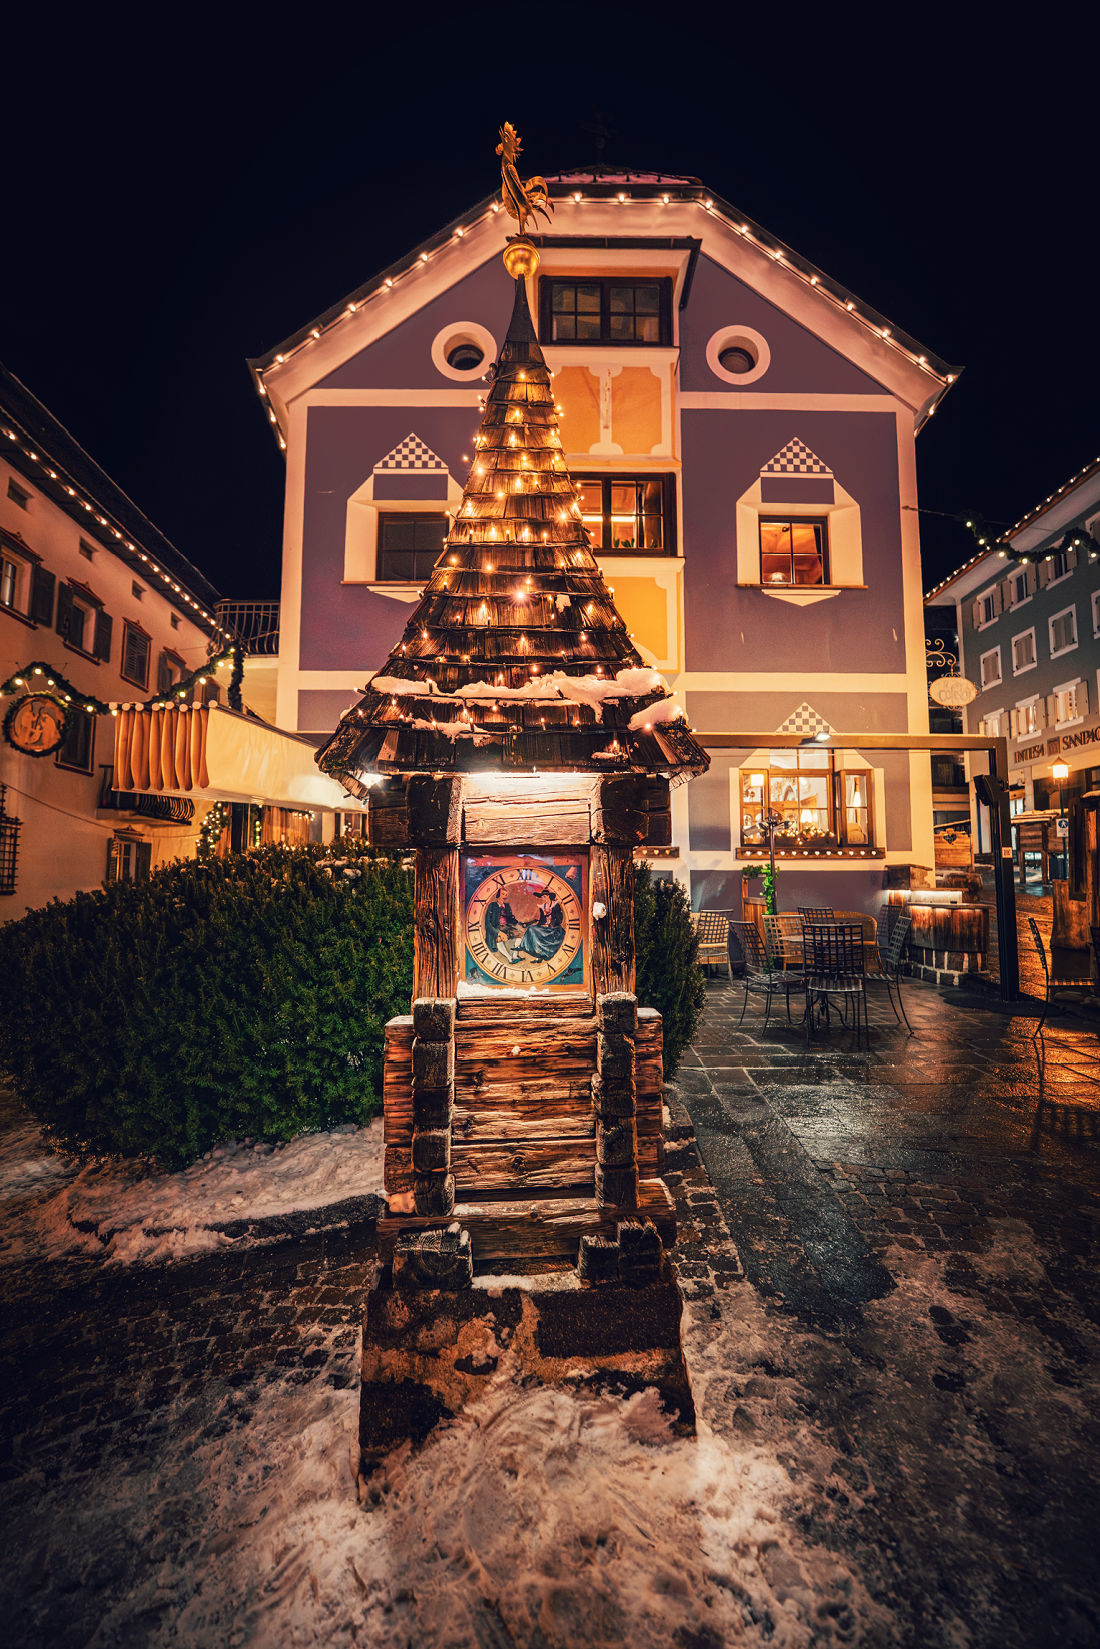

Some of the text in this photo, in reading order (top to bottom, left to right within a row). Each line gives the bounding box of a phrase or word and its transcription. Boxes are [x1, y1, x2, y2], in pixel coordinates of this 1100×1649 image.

[1014, 744, 1045, 763] INTESA
[491, 873, 506, 889] XI
[516, 868, 533, 881] XII
[473, 895, 487, 907] X
[560, 893, 575, 906] II
[467, 921, 480, 932] IX
[568, 918, 580, 930] III
[471, 941, 489, 964] VIII
[562, 943, 575, 959] IV
[491, 962, 507, 979] VII
[546, 962, 557, 976] V
[521, 970, 534, 982] VI
